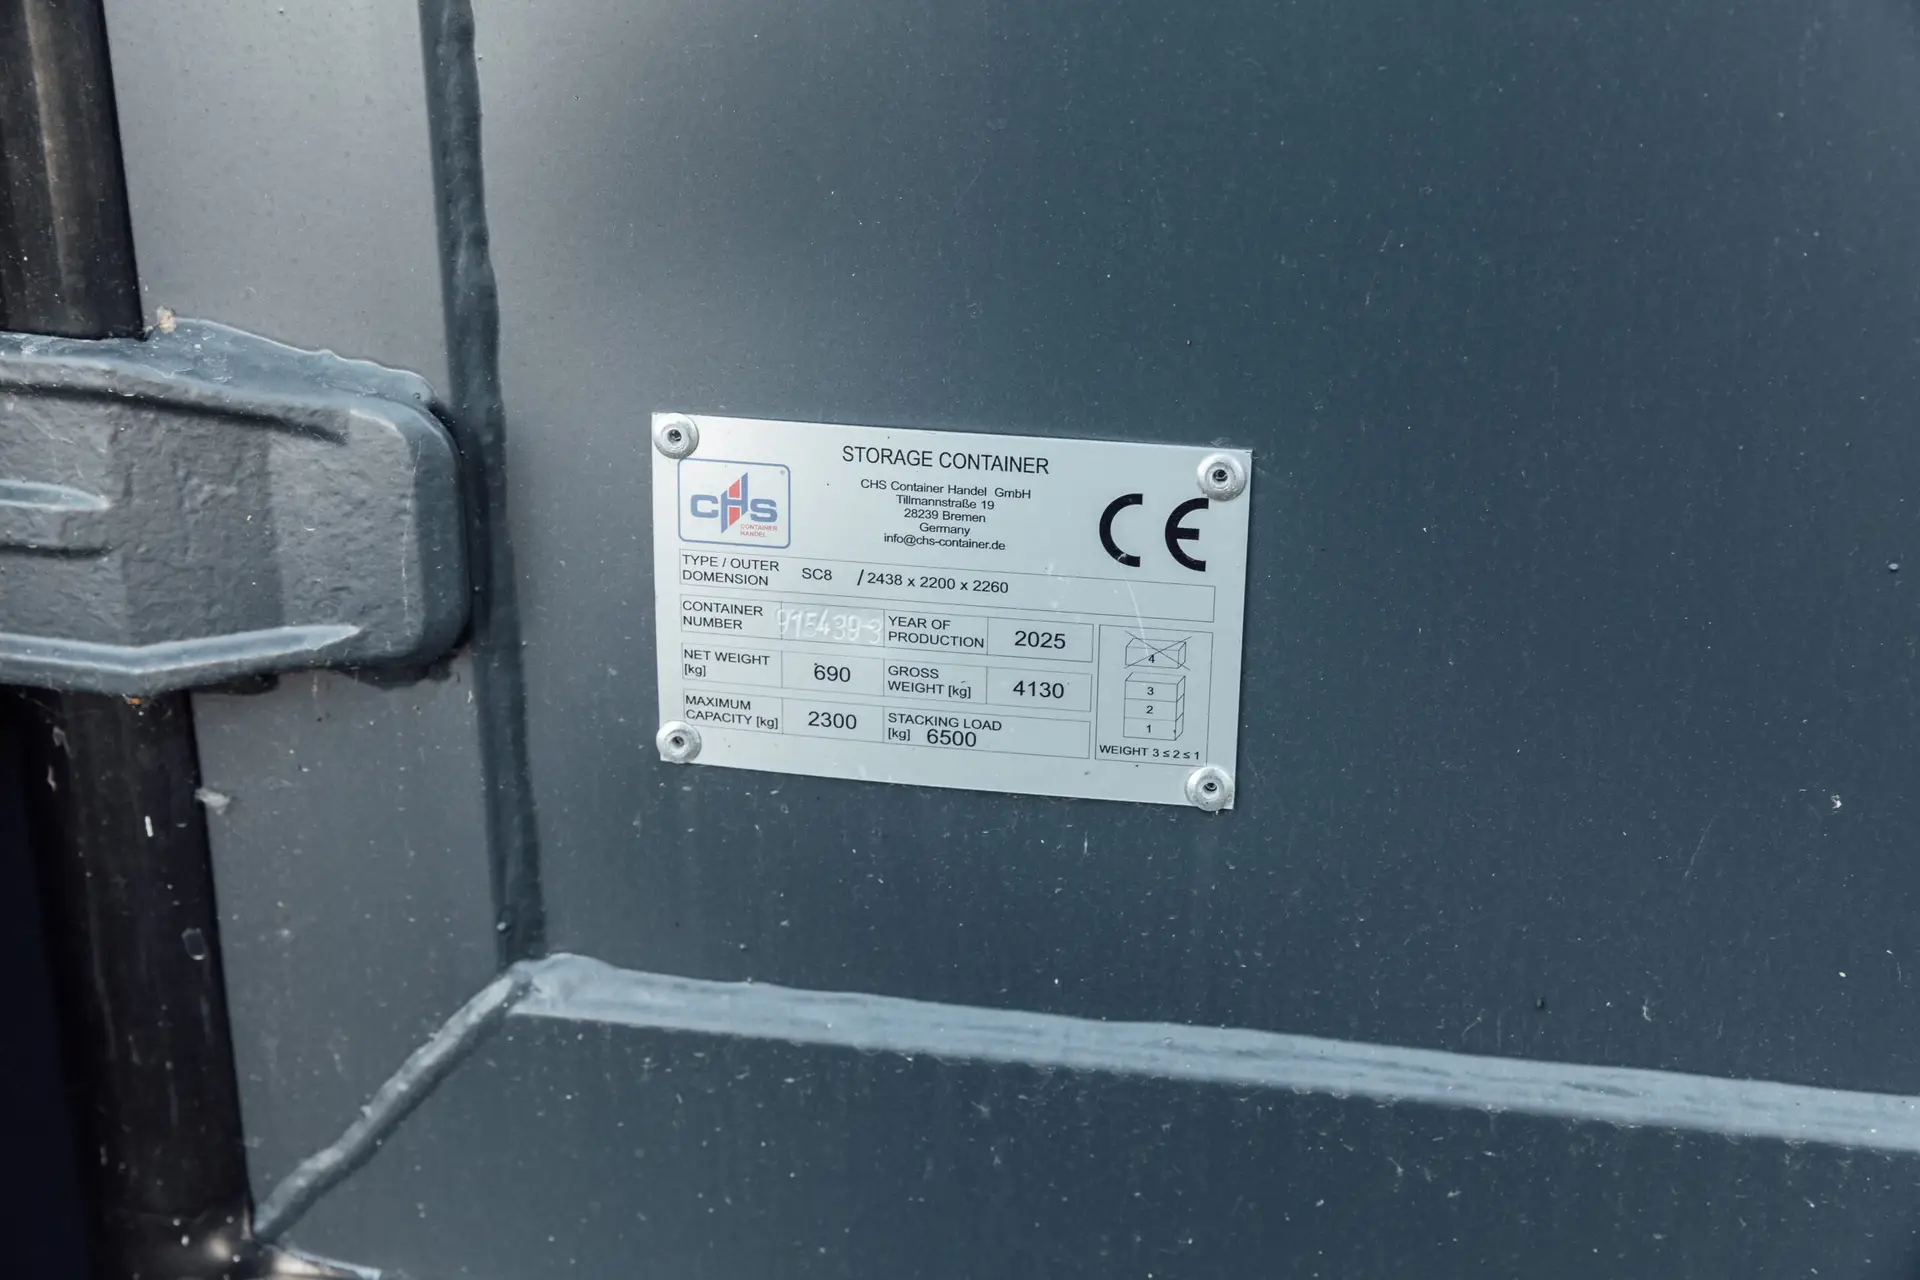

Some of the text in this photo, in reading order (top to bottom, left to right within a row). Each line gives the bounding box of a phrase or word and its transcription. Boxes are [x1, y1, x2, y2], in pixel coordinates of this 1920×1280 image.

[842, 445, 1050, 475] STORAGE CONTAINER
[860, 478, 1031, 499] CHS Container Handel GmbH
[690, 472, 778, 534] CHS
[896, 494, 995, 510] Tillmannstraße 19
[904, 508, 986, 523] 28239 Bremen
[740, 523, 778, 532] CONTAINER
[740, 530, 766, 538] HANDEL
[919, 522, 971, 537] Germany
[884, 533, 1006, 550] info@chs-container.de
[682, 554, 779, 571] TYPE / OUTER
[682, 569, 769, 586] DOMENSION
[801, 568, 833, 581] SC8
[907, 577, 916, 587] x
[919, 576, 956, 590] 2200
[960, 581, 968, 591] x
[972, 579, 1009, 593] 2260
[682, 600, 764, 616] CONTAINER
[683, 616, 743, 630] NUMBER
[888, 615, 951, 630] YEAR OF
[888, 631, 984, 648] PRODUCTION
[1014, 630, 1066, 649] 2025
[684, 649, 770, 666] NET WEIGHT
[1147, 654, 1156, 664] 4
[684, 664, 706, 677] [kg]
[814, 664, 851, 683] 690
[888, 665, 939, 679] GROSS
[888, 680, 971, 699] WEIGHT [kg]
[1013, 680, 1064, 699] 4130
[1146, 686, 1155, 696] 3
[685, 695, 751, 710] MAXIMUM
[1146, 705, 1154, 714] 2
[685, 709, 779, 730] CAPACITY [kg]
[808, 711, 857, 730] 2300
[888, 713, 1002, 731] STACKING LOAD
[888, 727, 977, 748] [kg] 6500
[1146, 724, 1152, 734] 1
[1099, 744, 1148, 757] WEIGHT
[1153, 748, 1160, 758] 3
[1173, 749, 1180, 759] 2
[1195, 751, 1200, 760] 1
